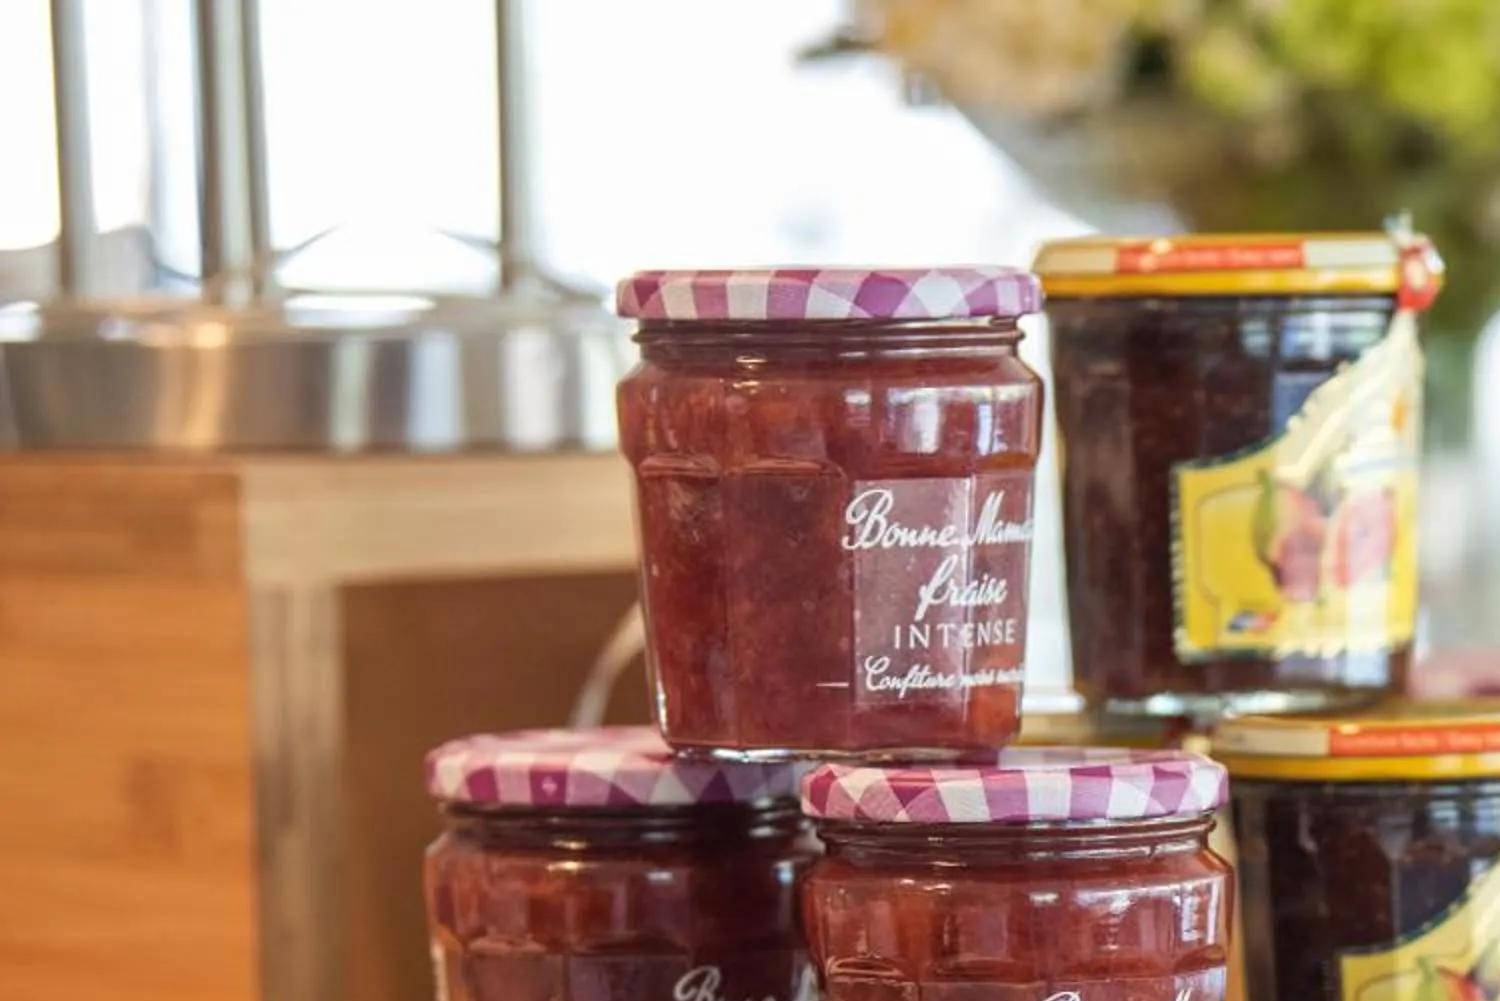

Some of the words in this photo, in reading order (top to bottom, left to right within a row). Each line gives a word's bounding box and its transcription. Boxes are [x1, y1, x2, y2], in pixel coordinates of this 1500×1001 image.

[842, 488, 962, 550] Bonne
[914, 553, 1008, 621] fraise
[893, 617, 1017, 650] INTENSE
[864, 654, 954, 698] Confiture
